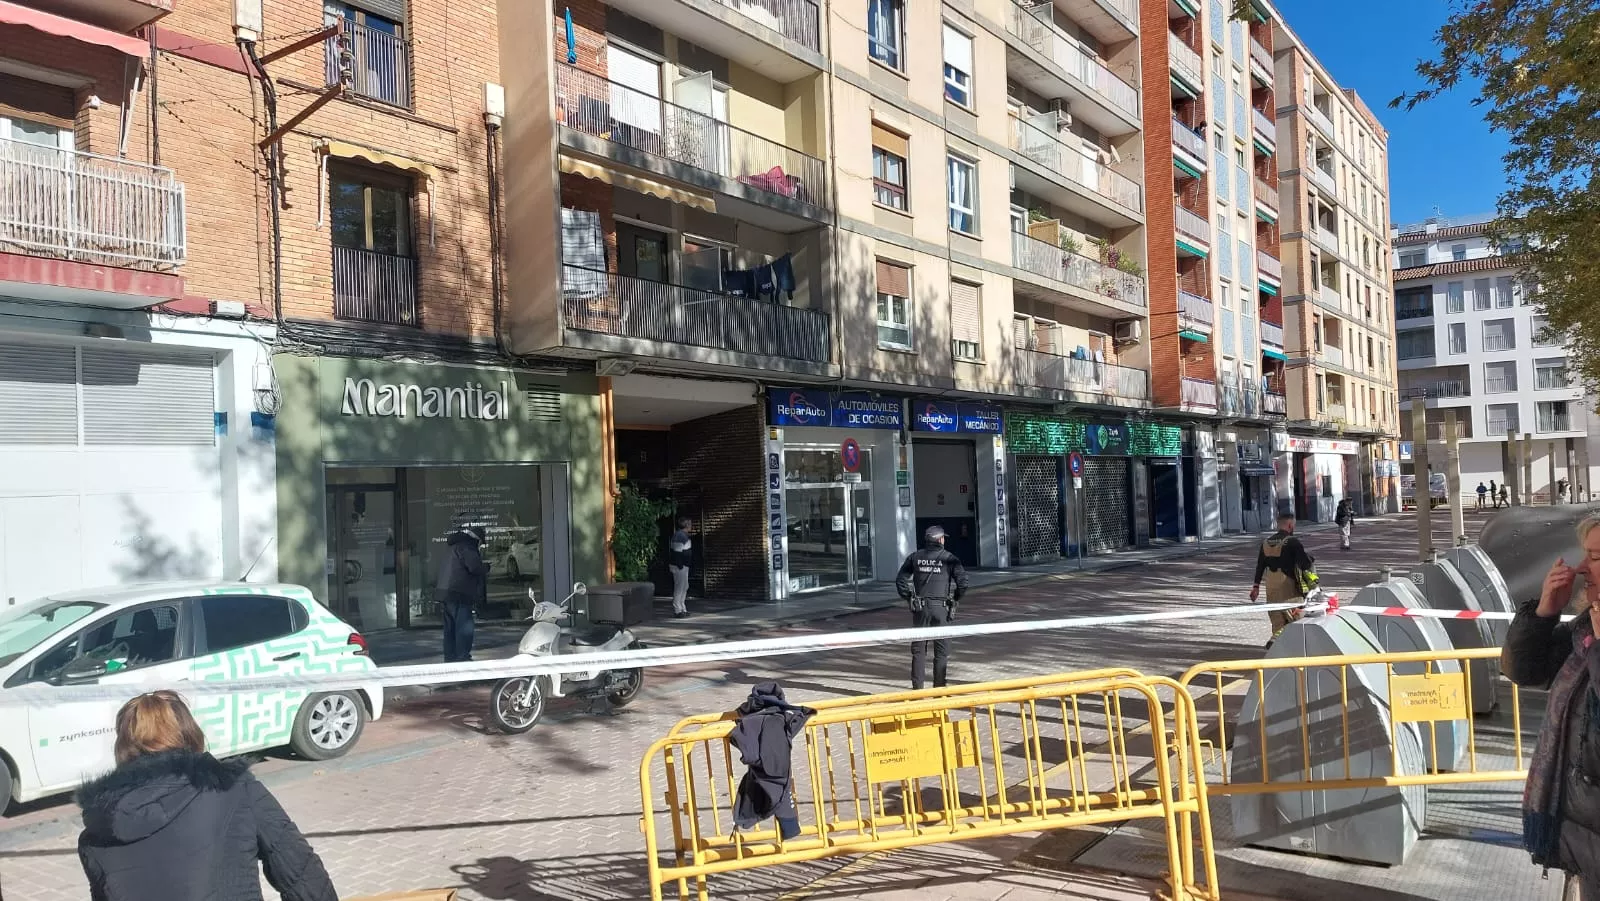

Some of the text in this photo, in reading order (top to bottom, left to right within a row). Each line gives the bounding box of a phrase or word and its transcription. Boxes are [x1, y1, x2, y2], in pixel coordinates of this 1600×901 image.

[342, 377, 509, 420] Manantial
[777, 404, 826, 417] ReparAuto
[838, 399, 899, 413] AUTOMÓVILES
[848, 412, 899, 425] DE OCASIÓN
[917, 413, 953, 425] ReparAuto
[976, 410, 999, 420] TALLER
[965, 419, 999, 431] MECÁNICO
[917, 559, 943, 567] POLICA
